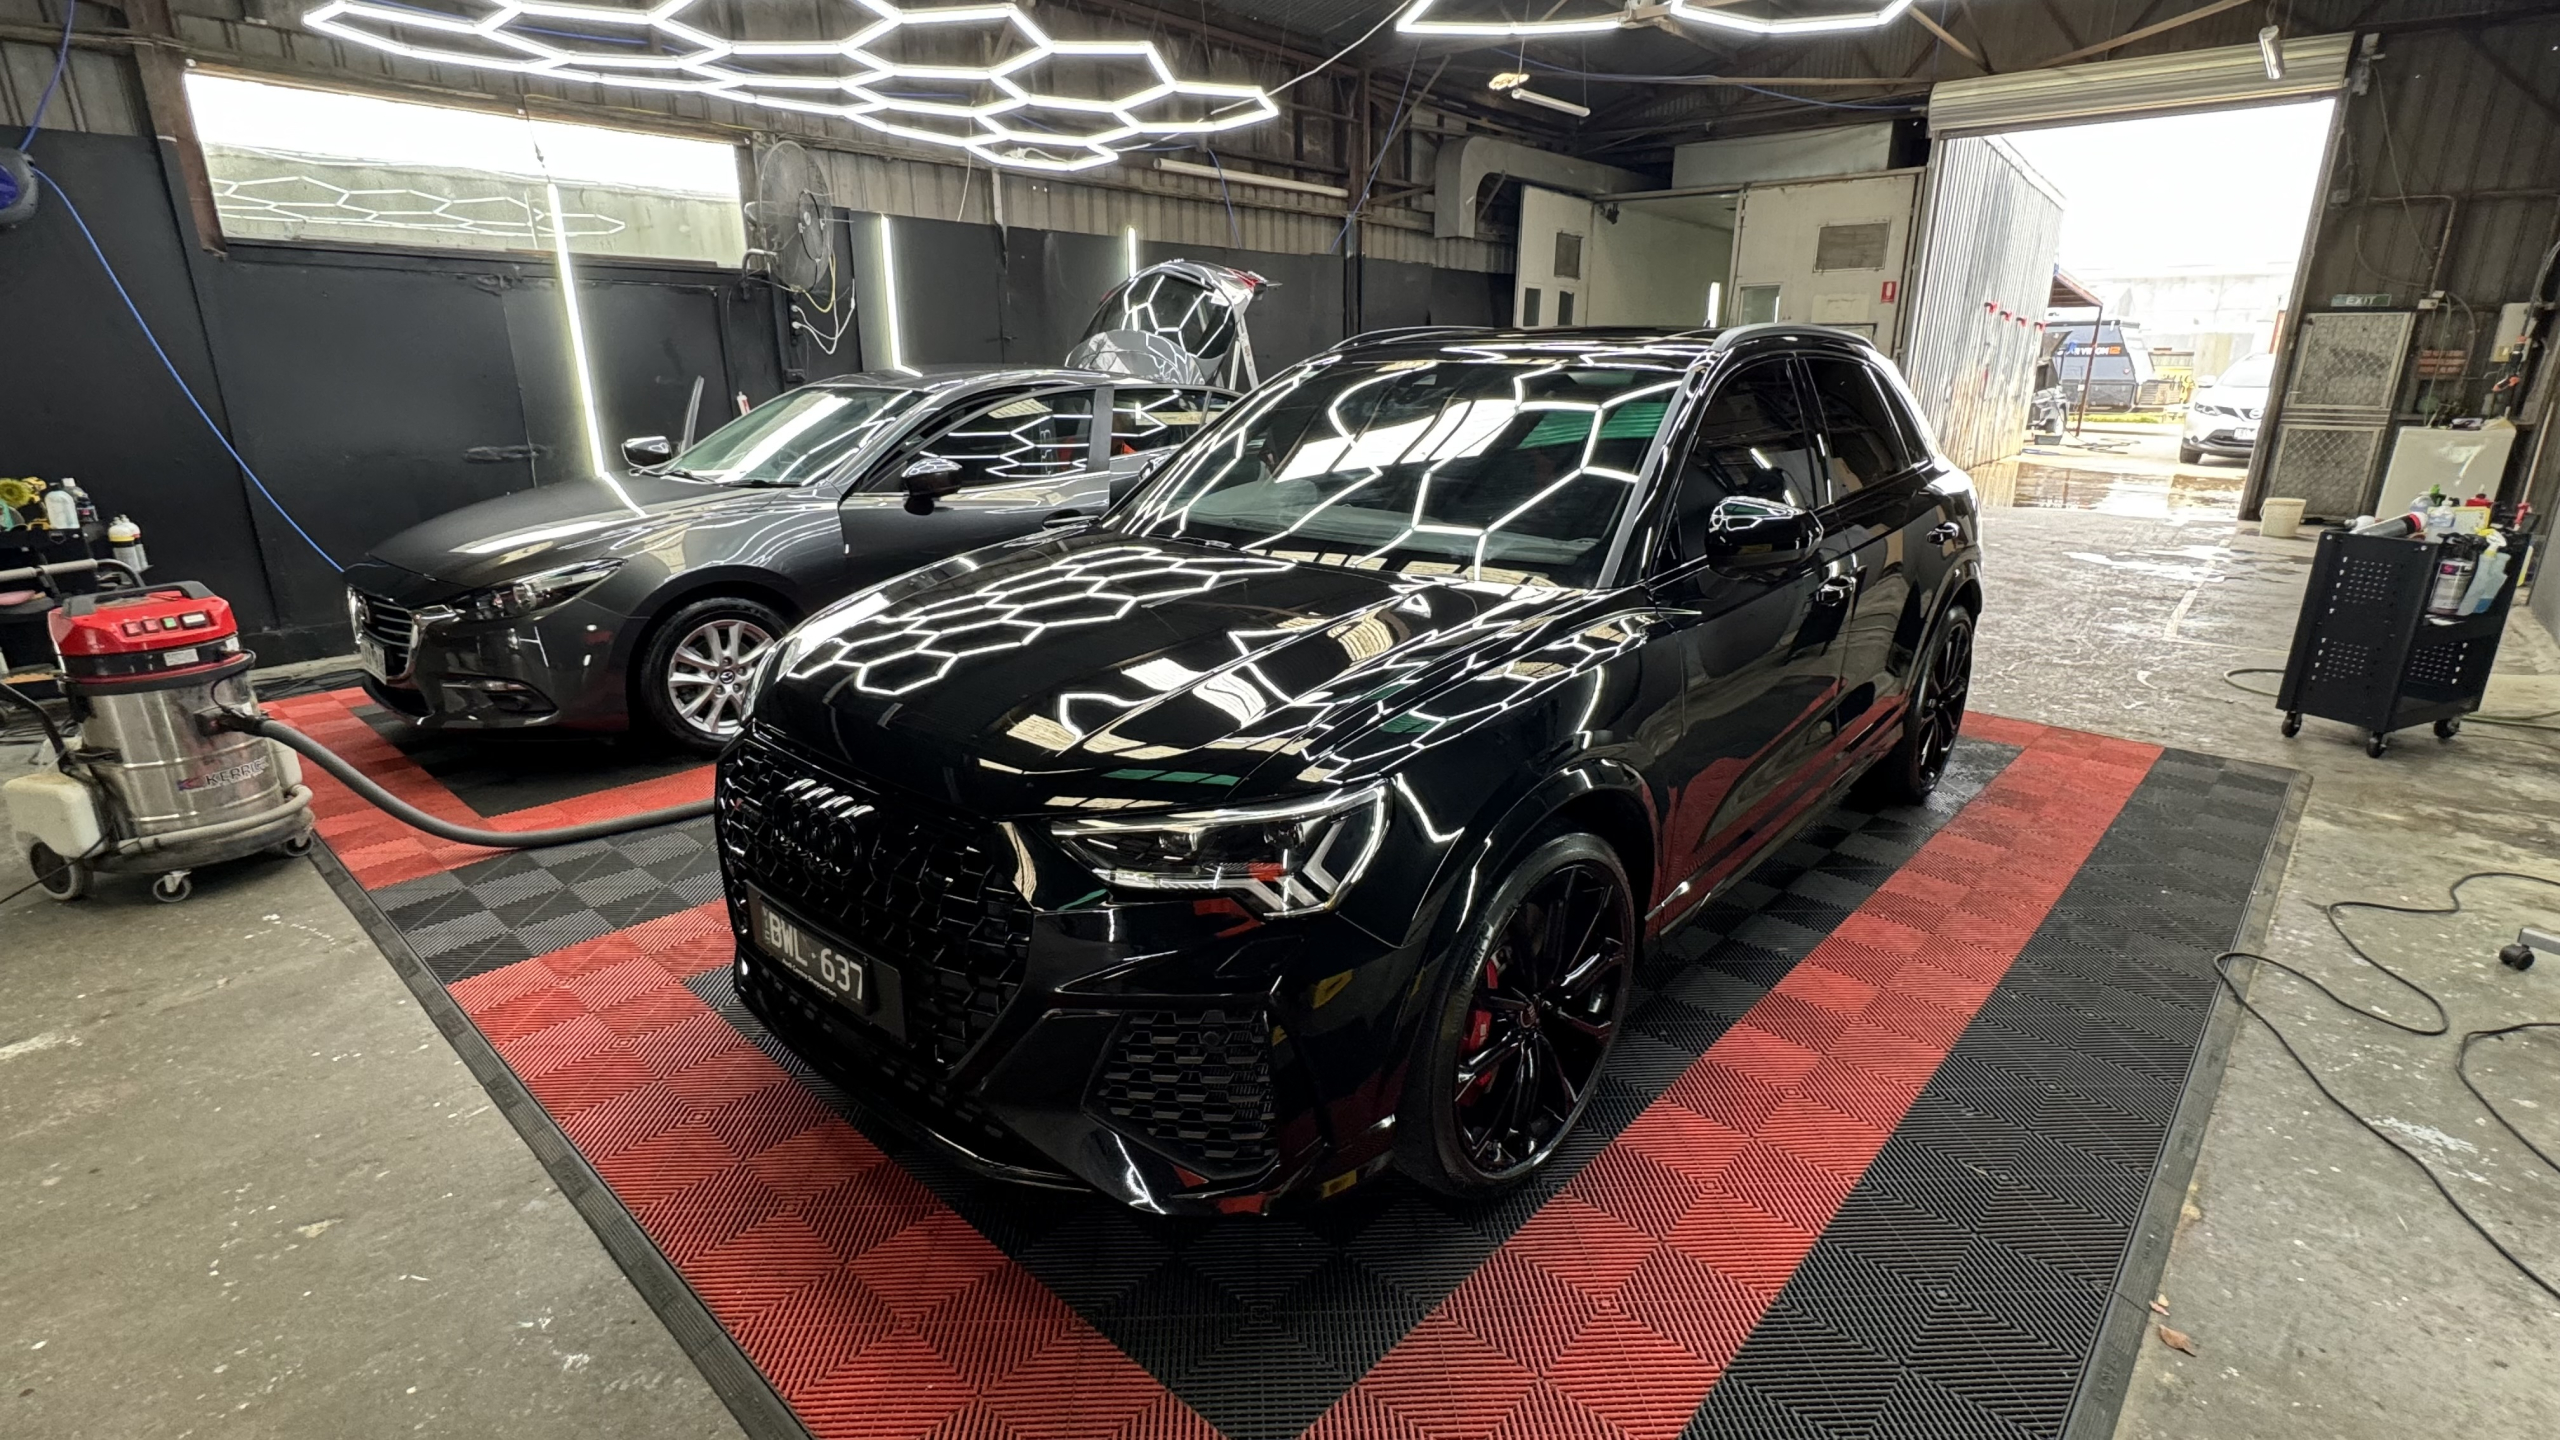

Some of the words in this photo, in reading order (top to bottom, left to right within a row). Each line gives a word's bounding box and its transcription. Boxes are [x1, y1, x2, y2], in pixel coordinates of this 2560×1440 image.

[2345, 295, 2378, 305] EXIT
[768, 912, 808, 967] BWL
[820, 948, 863, 1001] 637
